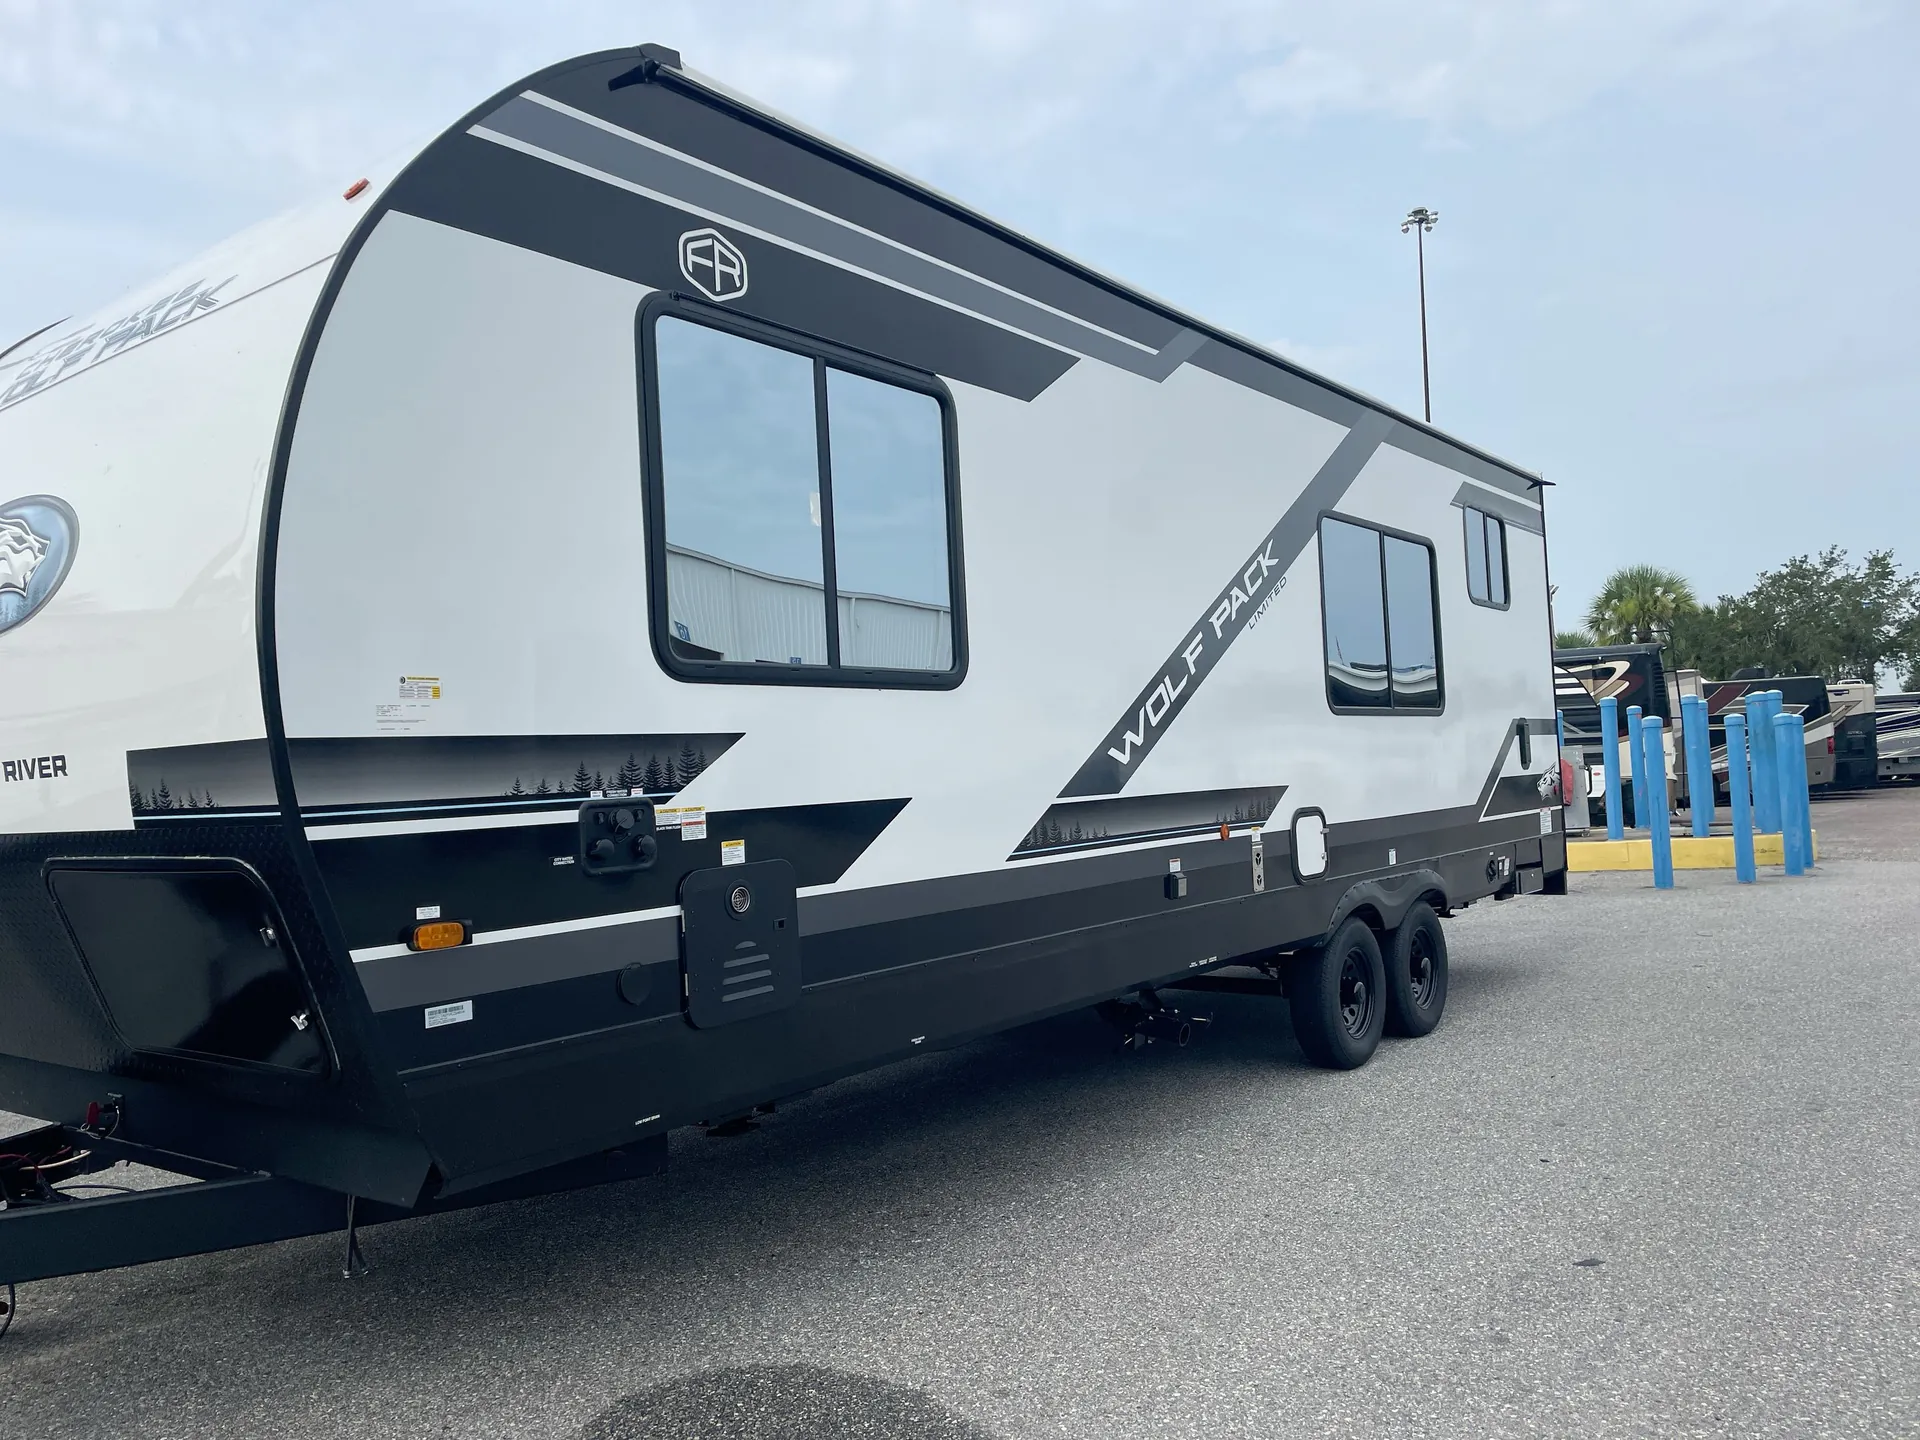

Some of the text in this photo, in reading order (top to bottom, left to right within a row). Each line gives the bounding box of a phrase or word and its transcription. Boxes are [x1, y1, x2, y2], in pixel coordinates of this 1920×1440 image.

[0, 274, 239, 408] OLF PACK
[15, 277, 207, 381] CHEROKEE
[1106, 538, 1280, 765] WOLF PACK
[1248, 575, 1288, 630] LIMITED
[1, 754, 69, 782] RIVER
